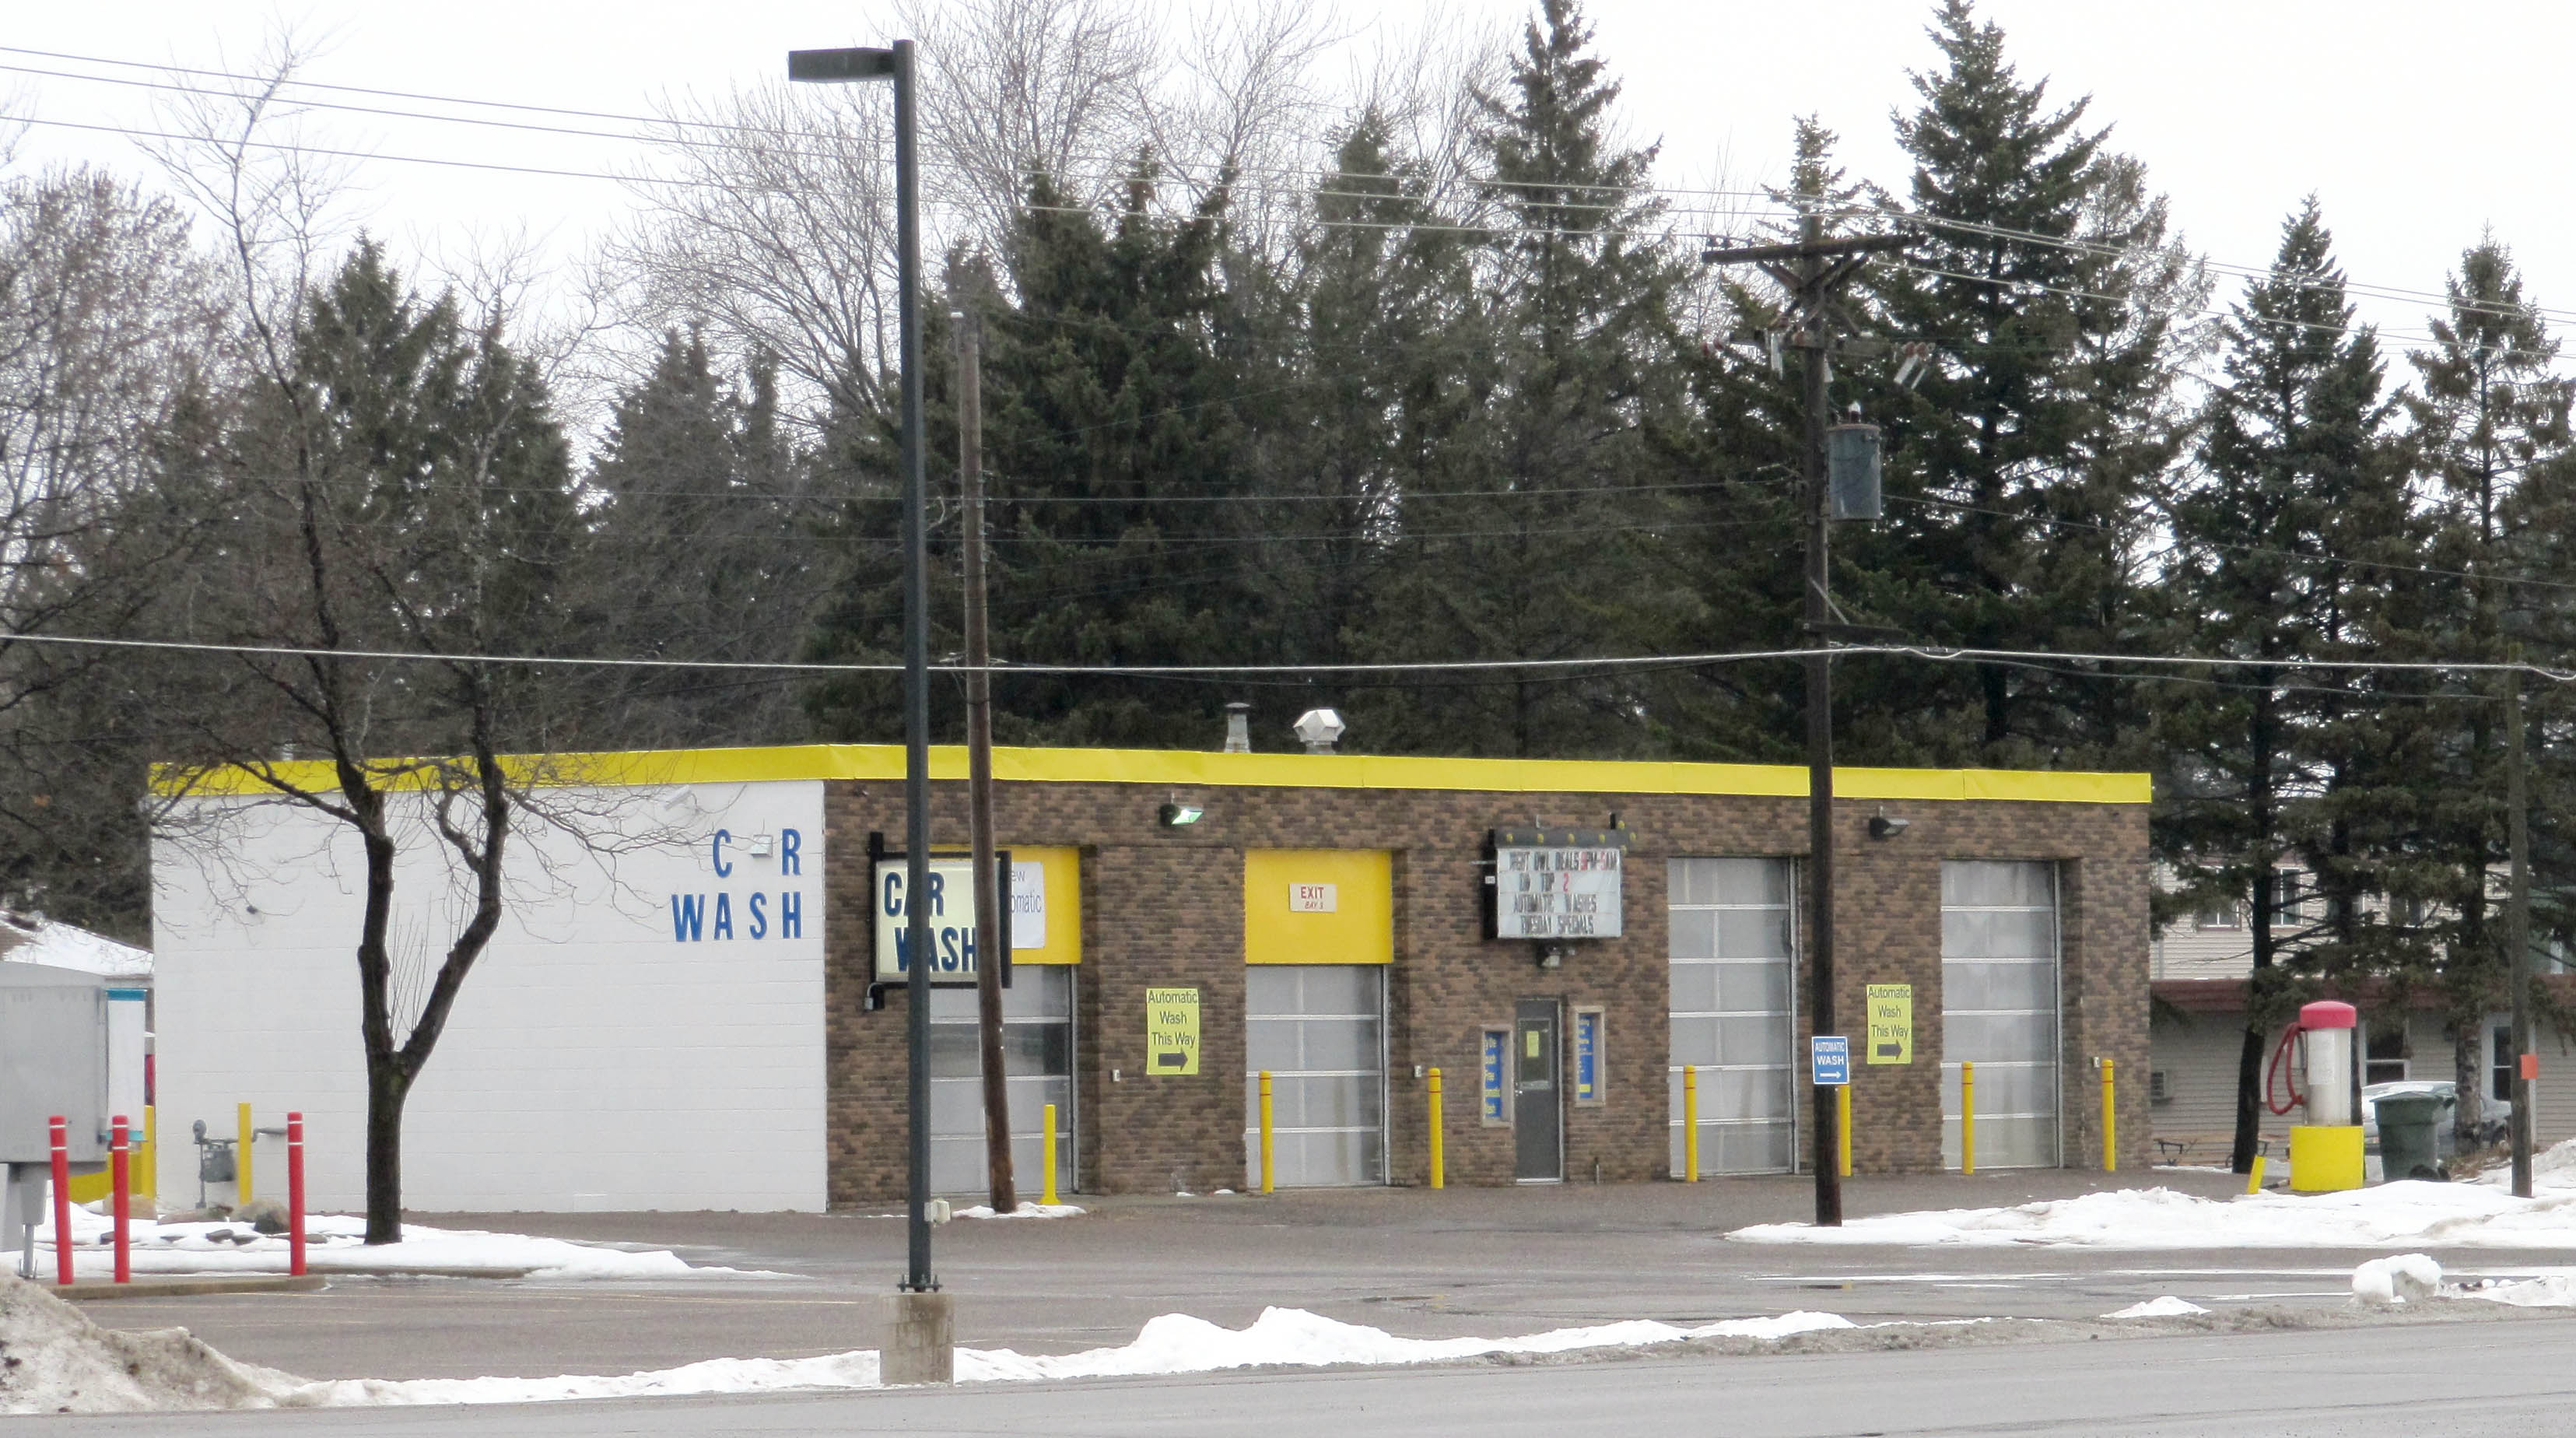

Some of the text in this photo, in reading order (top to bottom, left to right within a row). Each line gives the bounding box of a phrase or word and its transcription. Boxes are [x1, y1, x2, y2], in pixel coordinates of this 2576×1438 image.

[1563, 872, 1569, 892] 2
[1301, 886, 1324, 899] EXIT
[671, 892, 801, 942] WASH
[1148, 990, 1197, 1004] Automatic
[1868, 986, 1910, 998] Automatic
[1160, 1011, 1187, 1024] Wash
[1878, 1005, 1901, 1018] Wash
[1871, 1024, 1908, 1040] This Way
[1151, 1032, 1195, 1049] This Way
[1815, 1042, 1845, 1052] AUTOMATIC
[1817, 1055, 1844, 1065] WASH
